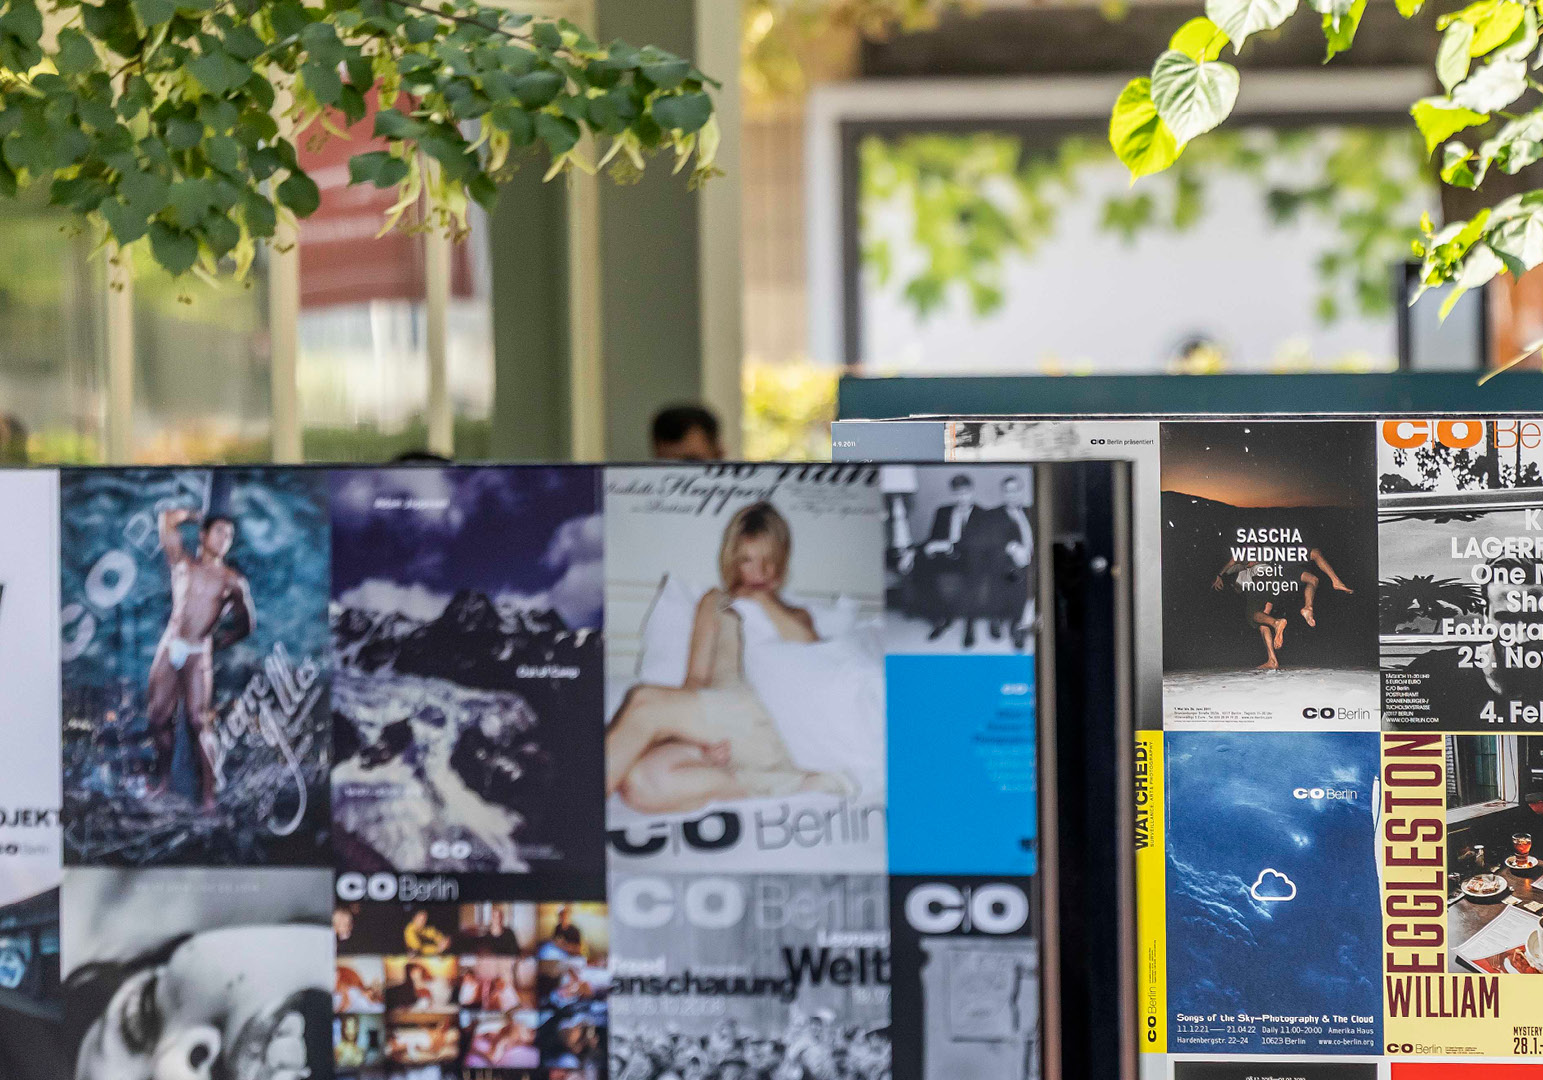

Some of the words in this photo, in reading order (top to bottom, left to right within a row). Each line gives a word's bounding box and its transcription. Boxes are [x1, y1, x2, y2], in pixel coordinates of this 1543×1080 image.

[1236, 528, 1303, 543] SASCHA
[1230, 547, 1309, 562] WEIDNER
[1256, 564, 1284, 577] seit
[1470, 564, 1527, 586] One
[1241, 579, 1299, 595] morgen
[1457, 646, 1498, 669] 25.
[1337, 707, 1371, 720] Berlin
[1480, 702, 1503, 724] 4.
[1326, 788, 1358, 800] Berlin
[754, 803, 888, 852] Berlin
[1384, 734, 1445, 974] EGGLESTON
[781, 946, 892, 988] Welt
[1386, 976, 1500, 1018] WILLIAM
[1176, 1013, 1205, 1023] Songs
[1220, 1014, 1235, 1022] the
[1333, 1015, 1348, 1023] The
[1351, 1015, 1374, 1024] Cloud
[1328, 1027, 1355, 1035] Amerika
[1356, 1027, 1374, 1035] Haus
[1513, 1026, 1543, 1037] MYSTERY
[1176, 1036, 1227, 1045] Hardenbergstr.
[1284, 1037, 1306, 1045] Berlin
[1318, 1038, 1375, 1047] www.co-berlin.org
[1415, 1043, 1443, 1054] Berlin
